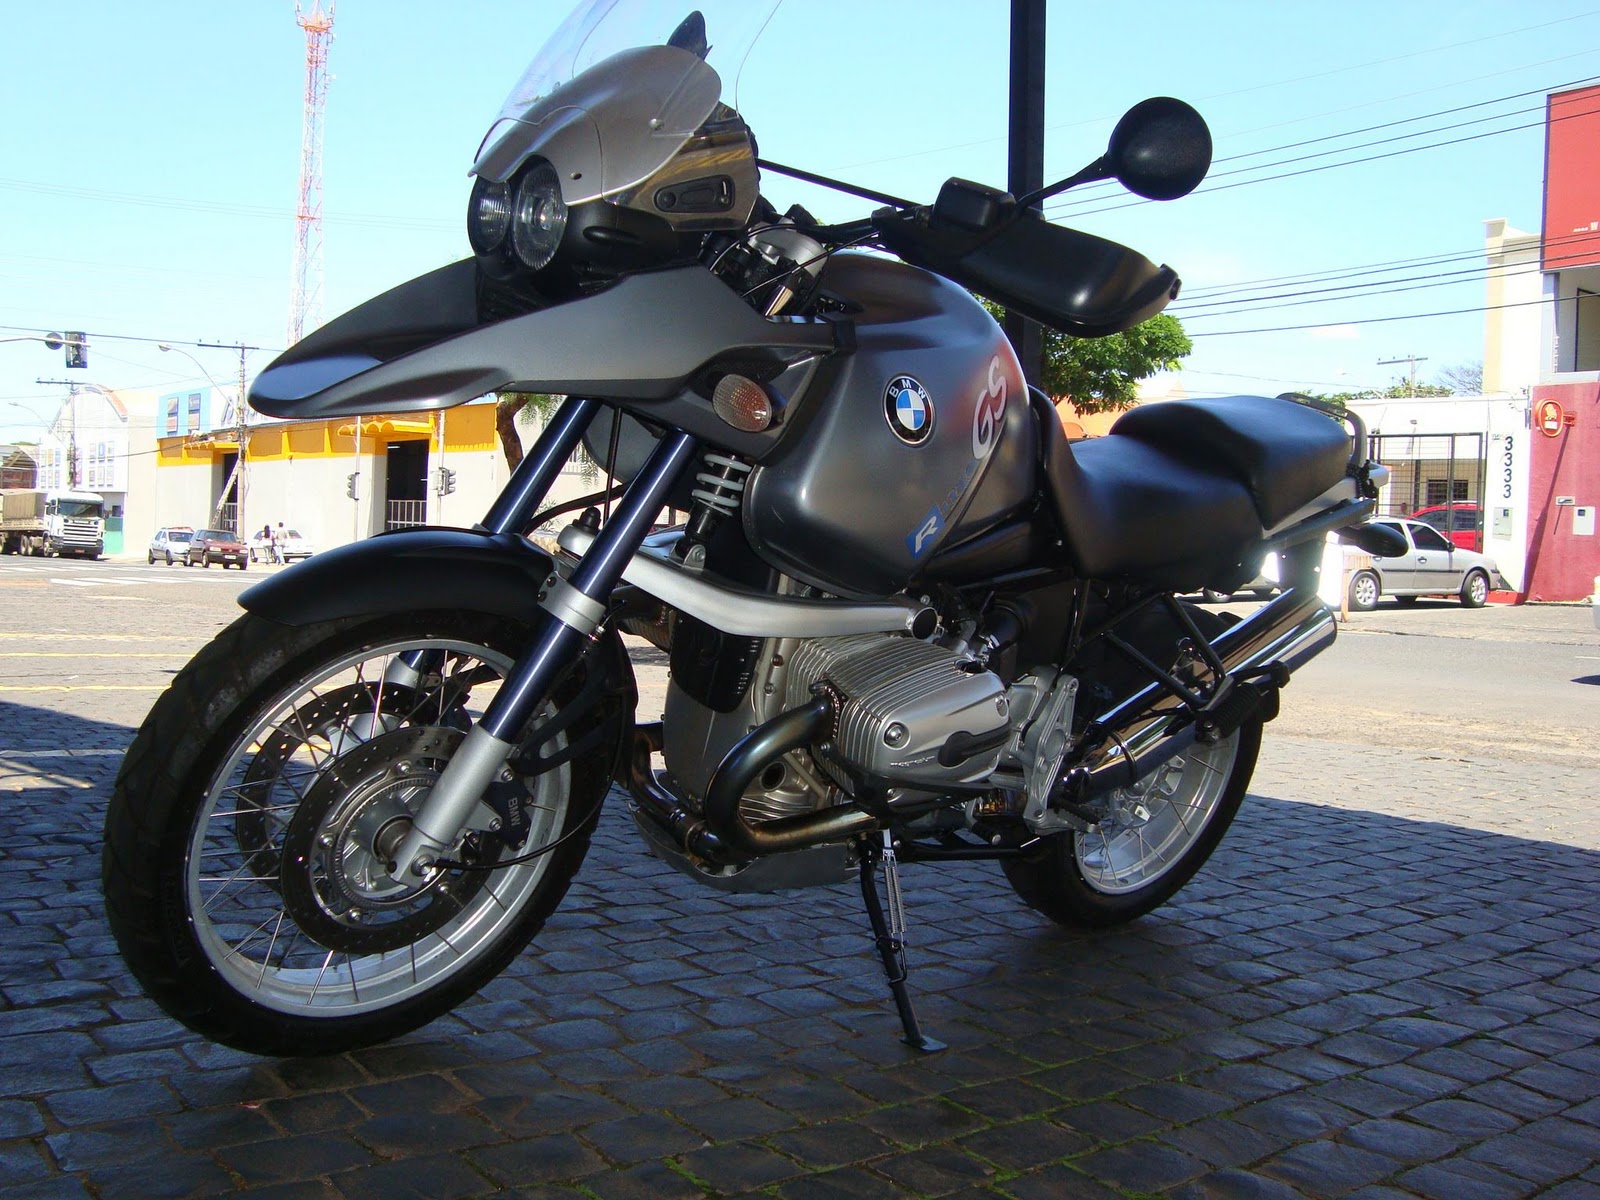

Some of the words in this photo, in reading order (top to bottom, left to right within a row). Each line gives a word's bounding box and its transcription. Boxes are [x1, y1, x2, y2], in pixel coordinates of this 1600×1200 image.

[889, 379, 926, 398] BMW
[915, 516, 938, 553] R
[973, 355, 1006, 459] GS
[1503, 436, 1513, 498] 3333
[508, 797, 520, 826] BMW
